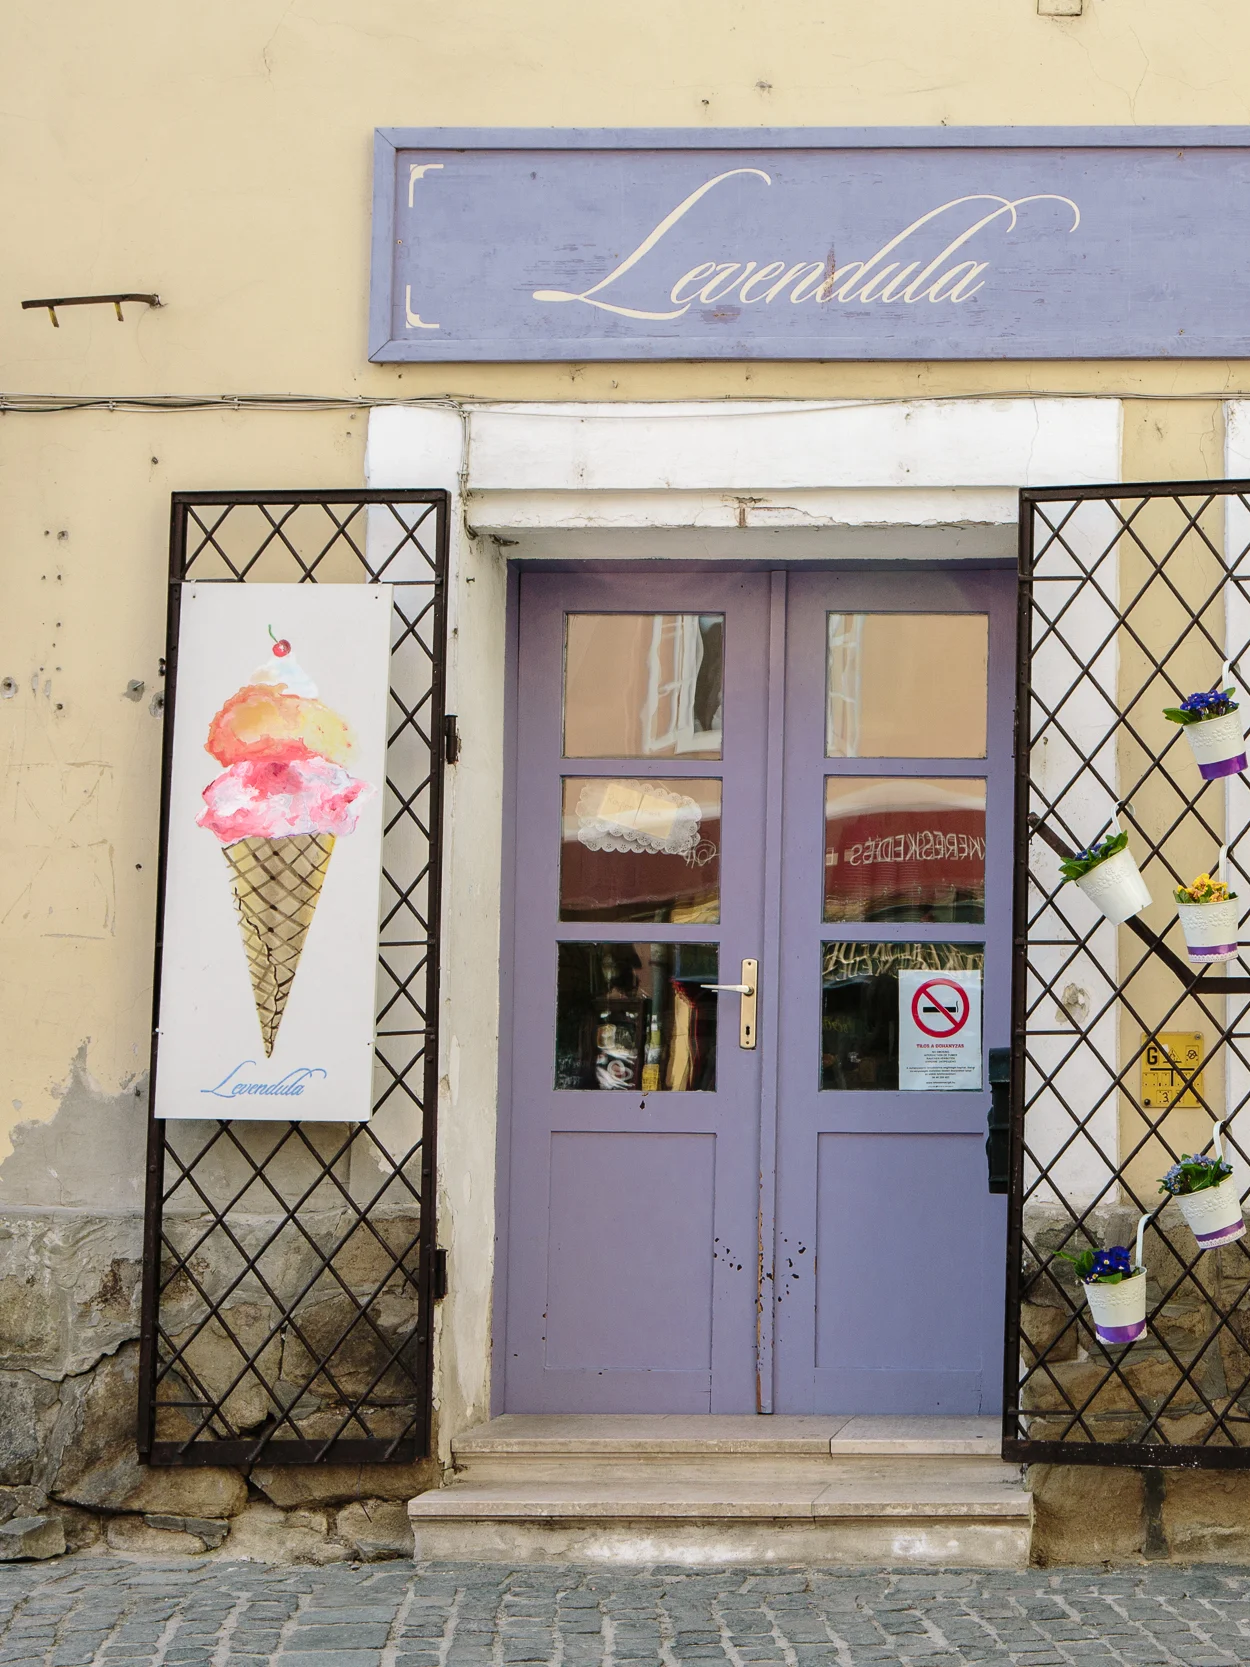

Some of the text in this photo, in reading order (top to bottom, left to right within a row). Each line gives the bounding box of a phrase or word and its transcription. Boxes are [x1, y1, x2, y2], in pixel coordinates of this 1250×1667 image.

[533, 168, 1080, 321] Levendula
[1147, 1047, 1158, 1065] G
[200, 1060, 327, 1098] Levendula
